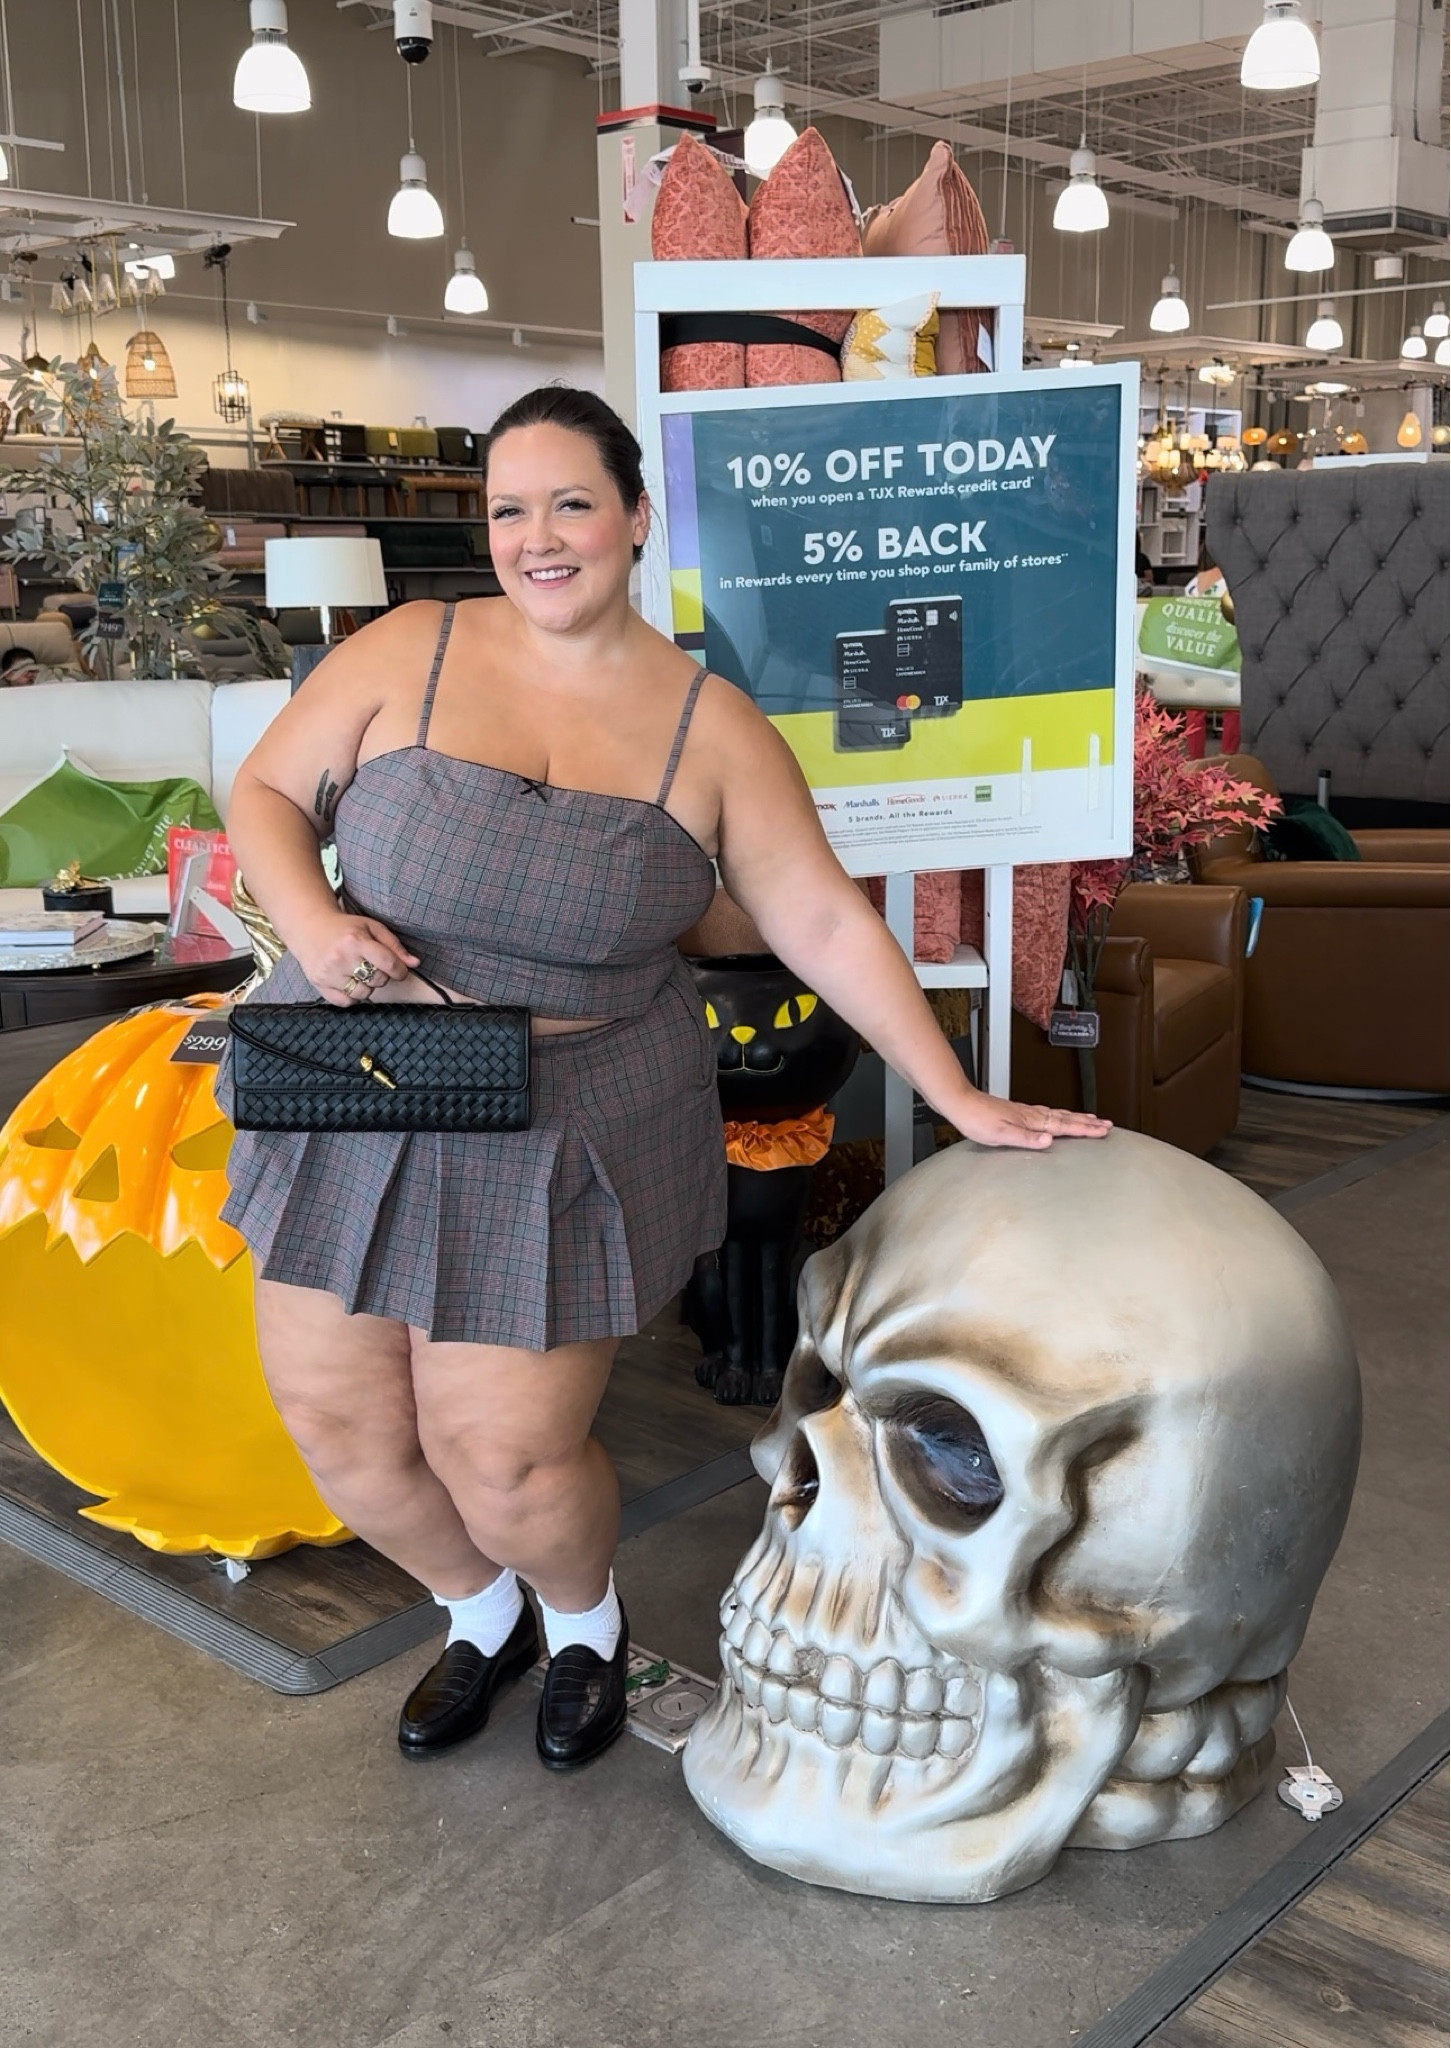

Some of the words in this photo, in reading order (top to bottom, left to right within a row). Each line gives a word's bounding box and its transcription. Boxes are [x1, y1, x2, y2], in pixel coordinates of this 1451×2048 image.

[726, 452, 811, 489] 10%
[825, 446, 904, 483] OFF
[917, 434, 1057, 476] TODAY
[751, 495, 788, 508] when
[791, 494, 816, 507] you
[819, 492, 853, 506] open
[856, 491, 865, 501] a
[868, 486, 894, 500] TJX
[898, 483, 955, 499] Rewards
[958, 479, 998, 493] credit
[803, 530, 863, 565] 5%
[878, 520, 988, 559] BACK
[720, 577, 732, 589] in
[736, 572, 792, 588] Rewards
[795, 571, 833, 585] every
[836, 567, 868, 581] time
[870, 567, 895, 581] you
[898, 563, 931, 578] shop
[933, 562, 956, 574] our
[959, 557, 1000, 573] family
[1003, 555, 1018, 569] of
[1162, 603, 1231, 627] QUALIT
[1166, 635, 1217, 658] VALUE
[848, 816, 854, 824] 5
[856, 814, 887, 823] brands.
[888, 811, 900, 819] All
[903, 810, 916, 818] the
[919, 808, 953, 817] Rewards
[183, 1034, 227, 1051] $299
